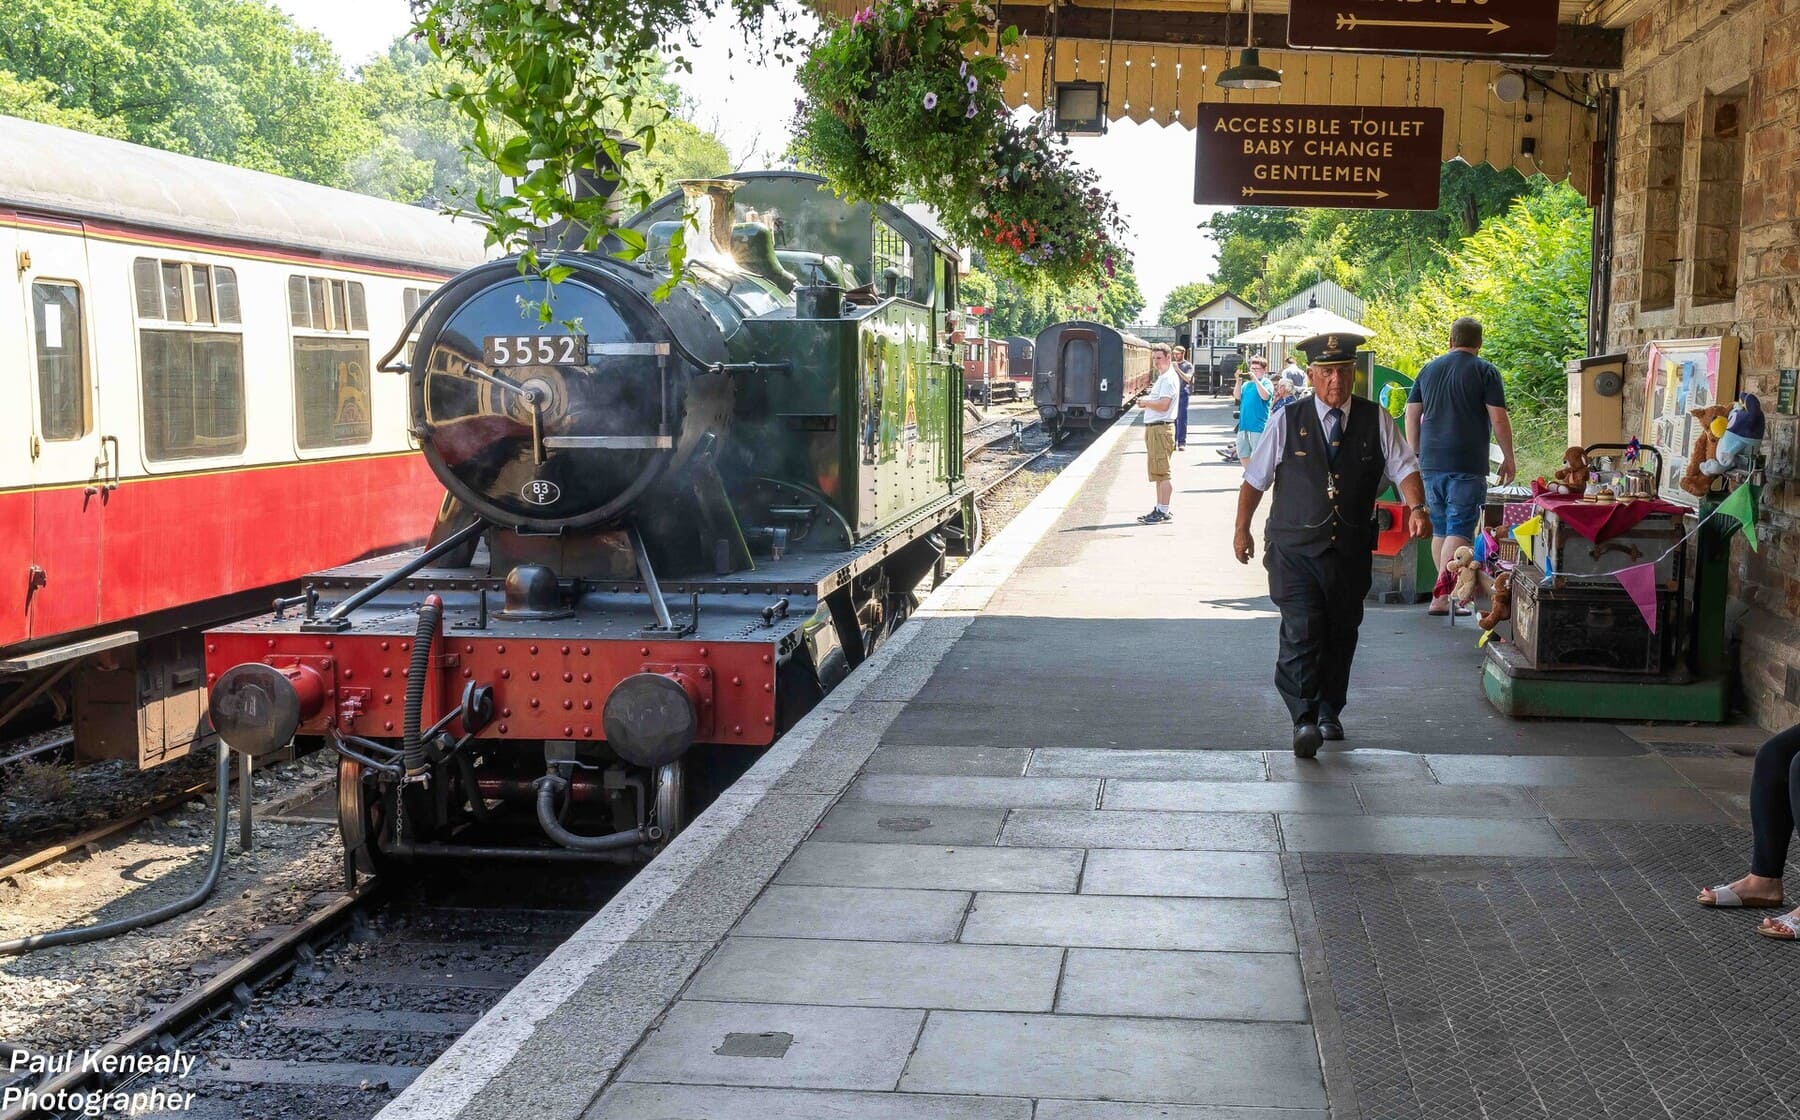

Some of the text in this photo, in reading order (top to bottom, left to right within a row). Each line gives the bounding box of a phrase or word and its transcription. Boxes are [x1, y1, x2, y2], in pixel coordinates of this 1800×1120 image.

[1214, 117, 1425, 137] ACCESSIBLE TOILET
[1243, 139, 1393, 157] BABY CHANGE
[1254, 164, 1380, 182] GENTLEMEN
[494, 336, 575, 364] 5552
[533, 482, 549, 494] 83
[538, 493, 545, 503] F
